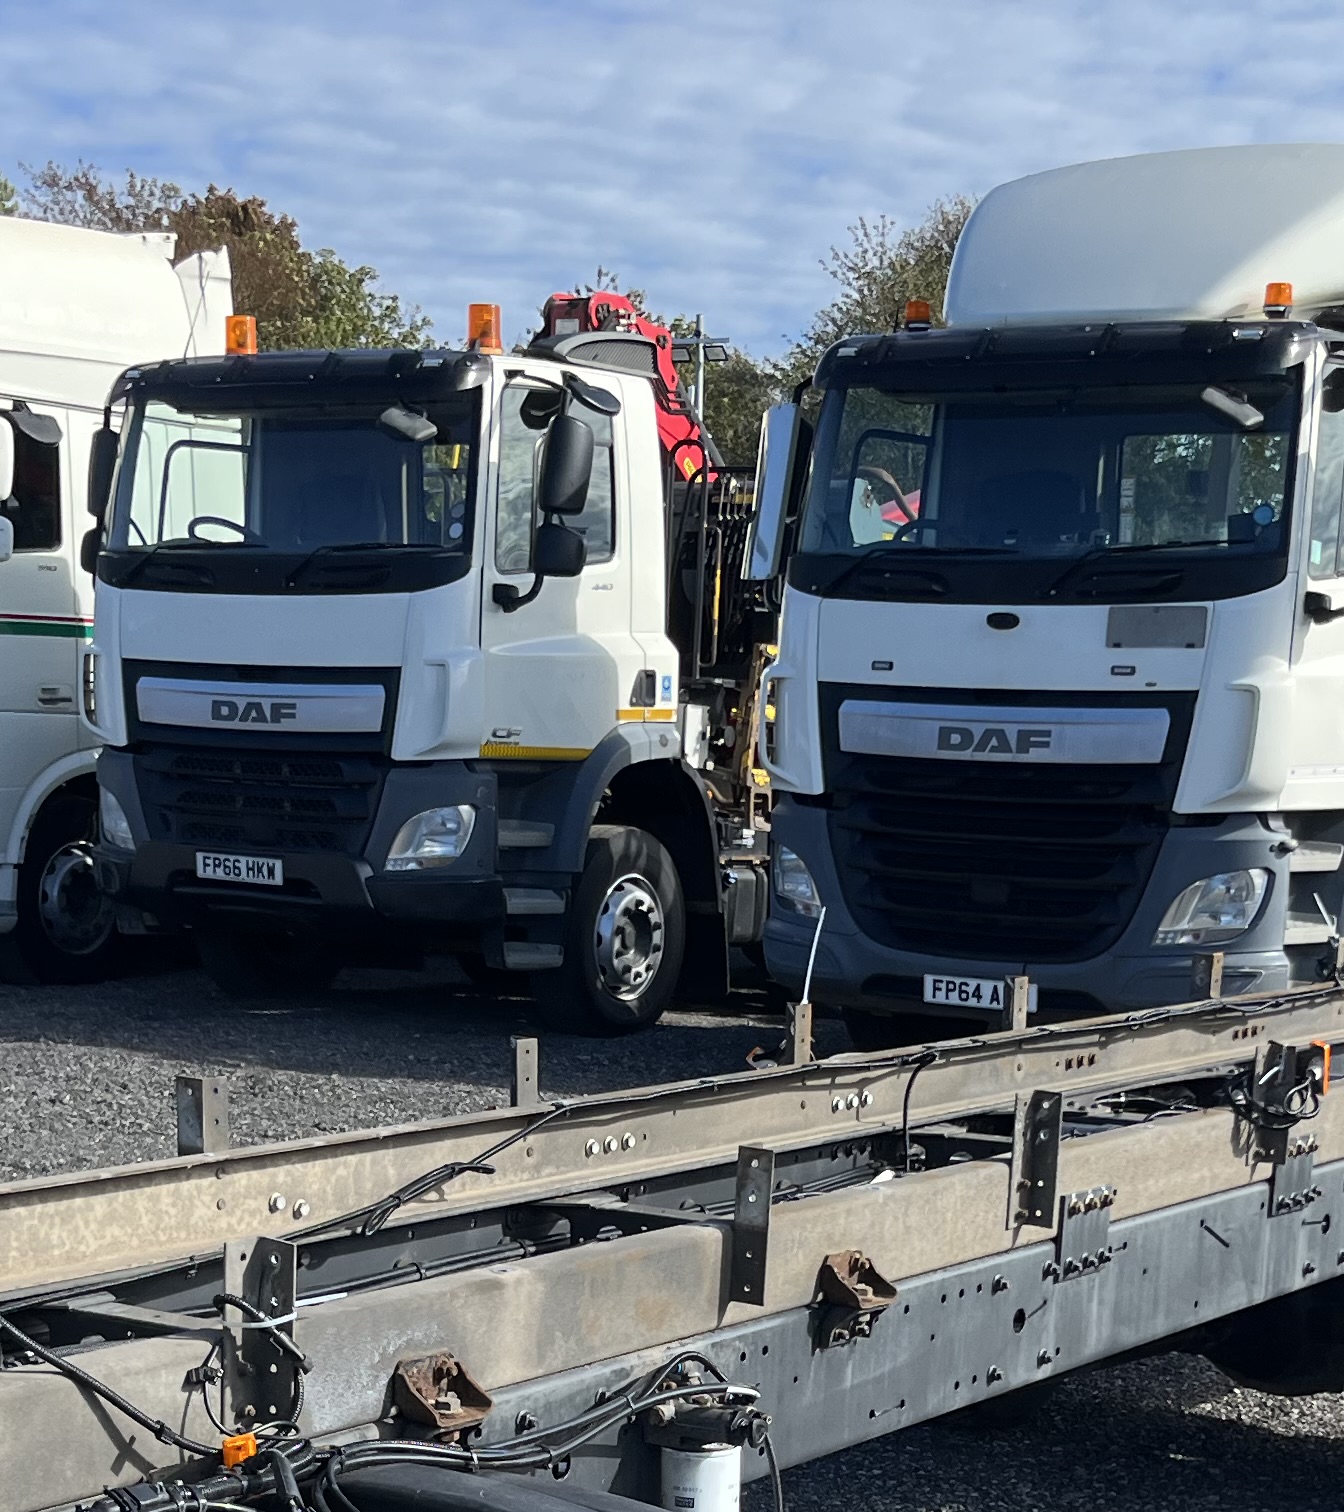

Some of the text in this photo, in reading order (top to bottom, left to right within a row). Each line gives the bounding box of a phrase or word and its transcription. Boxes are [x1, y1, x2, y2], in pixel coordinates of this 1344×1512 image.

[211, 699, 297, 724] DAF
[937, 726, 1052, 755] DAF
[202, 856, 276, 881] FP66 HKW
[932, 978, 983, 1004] FP64
